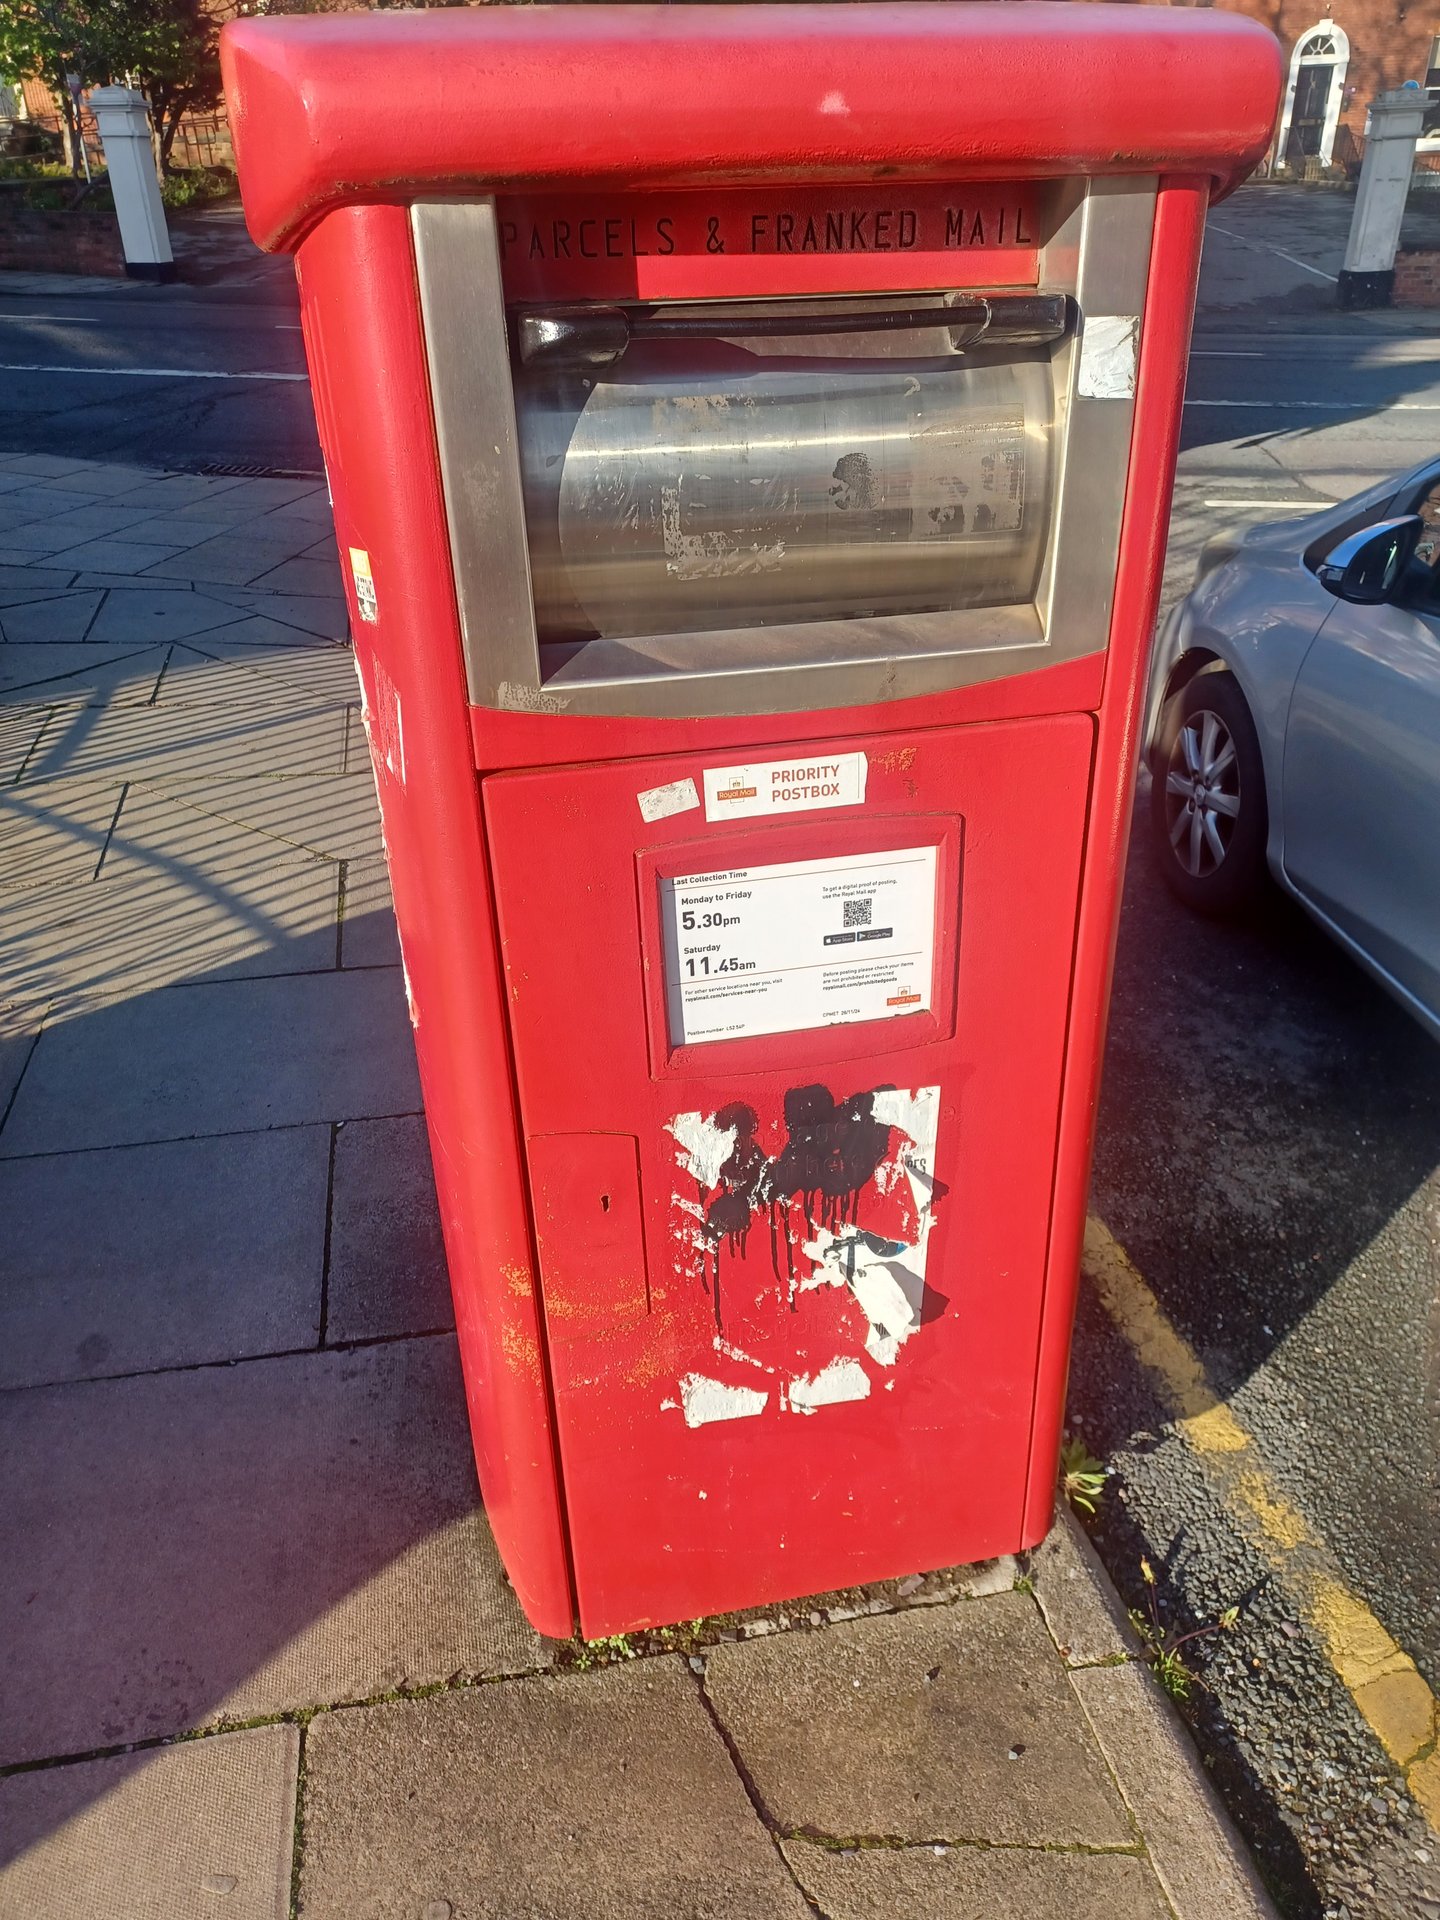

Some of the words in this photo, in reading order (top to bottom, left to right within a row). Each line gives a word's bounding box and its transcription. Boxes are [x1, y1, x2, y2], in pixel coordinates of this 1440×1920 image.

[503, 216, 676, 261] PARCELS
[706, 215, 726, 254] &
[751, 209, 918, 254] FRANKED
[945, 206, 1032, 247] MAIL
[771, 764, 840, 784] PRIORITY
[719, 790, 738, 799] Royal
[740, 788, 754, 796] Mail
[771, 782, 840, 802] POSTBOX
[672, 878, 688, 886] Last
[690, 874, 727, 884] Collection
[728, 870, 748, 878] Time
[681, 895, 714, 905] Monday
[726, 890, 752, 900] Friday
[682, 911, 741, 930] 5.30pm
[684, 944, 721, 954] Saturday
[686, 956, 756, 976] 11.45am
[841, 974, 864, 982] prohibited
